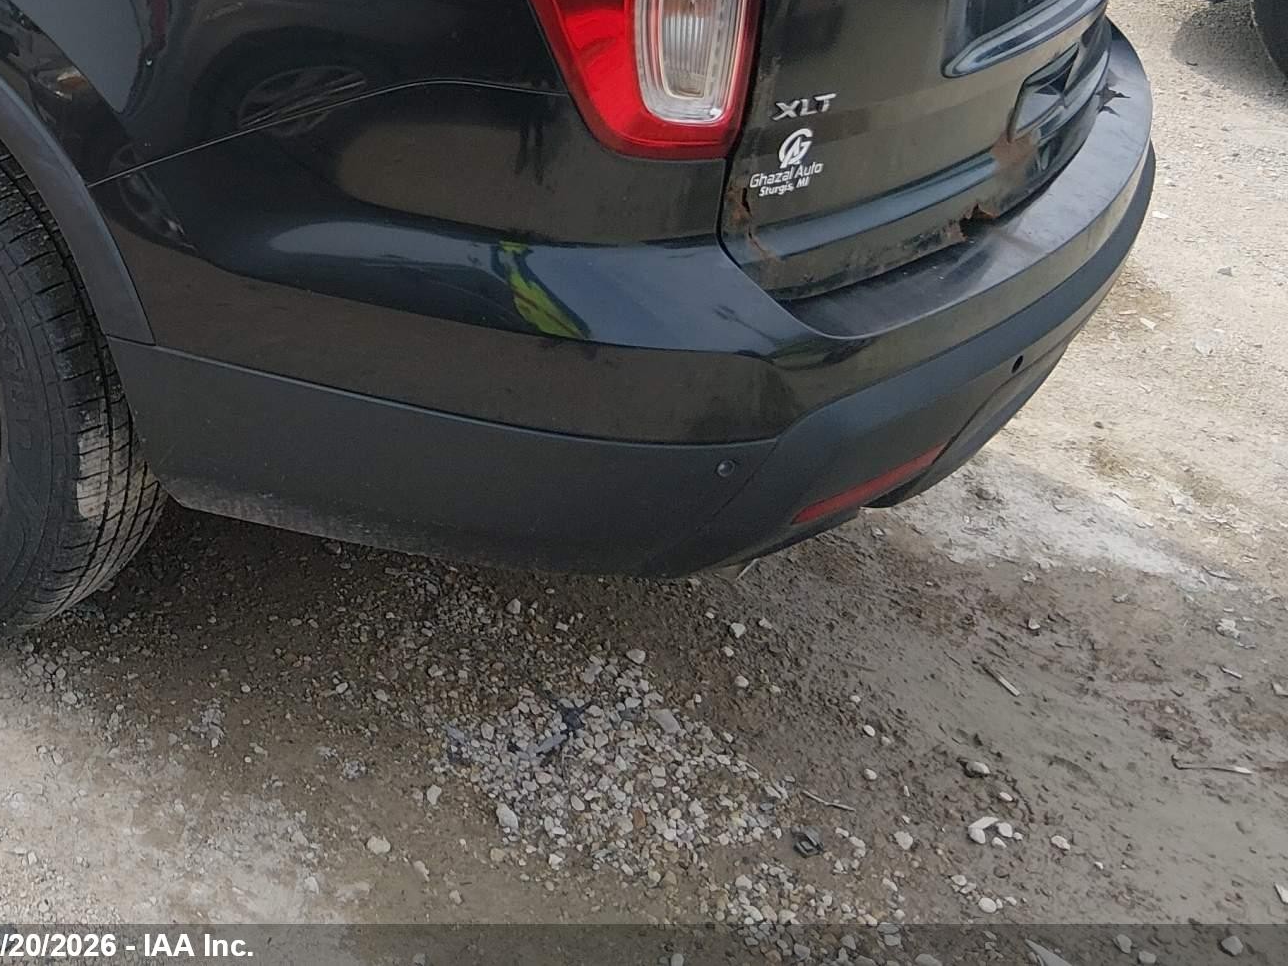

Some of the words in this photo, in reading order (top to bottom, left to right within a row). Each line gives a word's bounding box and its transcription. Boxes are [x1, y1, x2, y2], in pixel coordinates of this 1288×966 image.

[772, 92, 837, 121] XLT
[749, 167, 794, 188] Ghazal
[795, 161, 824, 178] Auto
[758, 181, 794, 197] Sturgis,
[796, 176, 810, 189] MI
